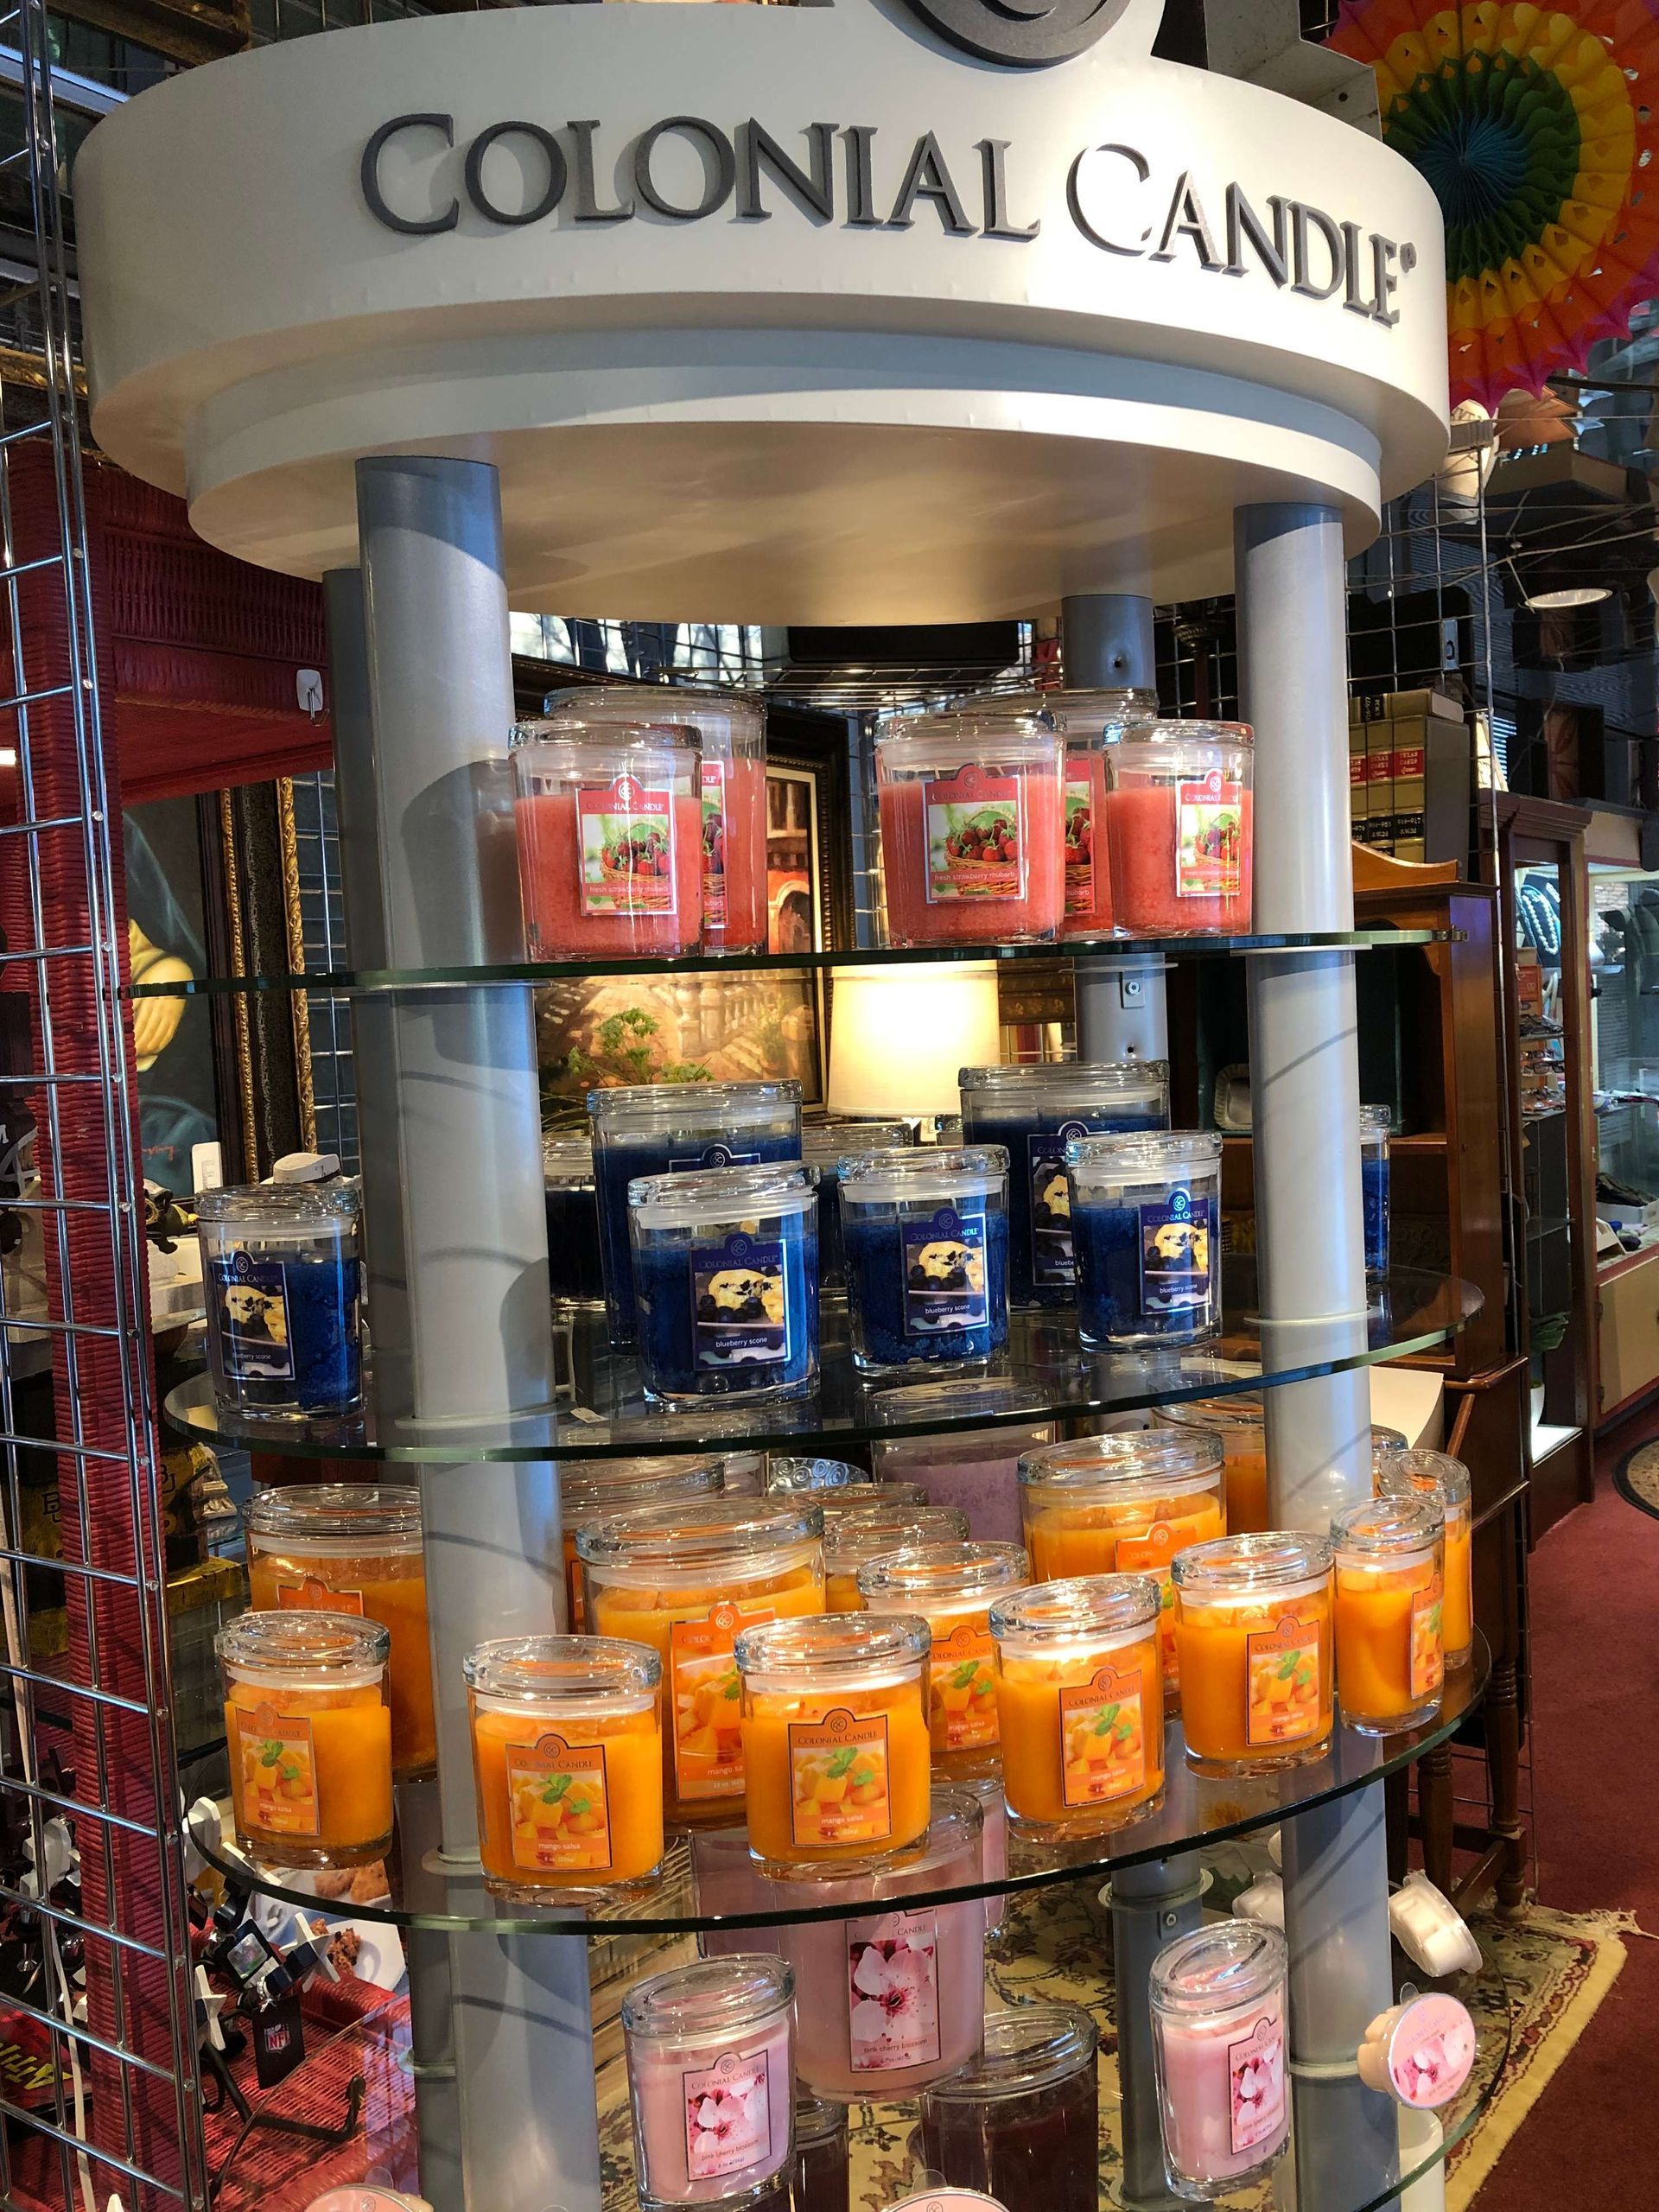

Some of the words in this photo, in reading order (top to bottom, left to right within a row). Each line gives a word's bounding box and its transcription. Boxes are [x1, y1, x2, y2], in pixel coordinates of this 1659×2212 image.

[360, 112, 1040, 243] COLONIAL
[934, 874, 951, 882] fresh
[952, 872, 988, 881] strawberry
[989, 870, 1015, 880] rhubarb
[1037, 1145, 1067, 1155] COLON
[1160, 1285, 1185, 1294] blueberry
[925, 1306, 954, 1315] blueberry
[715, 1339, 749, 1349] blueberry
[748, 1336, 768, 1344] scone
[232, 1351, 255, 1361] ueberry
[932, 1649, 967, 1660] OLONIAL
[798, 1735, 842, 1745] COLONIAL
[844, 1730, 876, 1743] CANDLE
[514, 1758, 555, 1770] CONIAL
[558, 1759, 592, 1770] CANDLE
[707, 1767, 733, 1777] mango
[821, 1816, 845, 1826] mango
[846, 1814, 864, 1822] salsa
[538, 1842, 561, 1852] mango
[897, 1924, 926, 1936] CANDLE
[901, 2038, 928, 2050] blossom
[691, 2077, 732, 2090] COLONIAL
[701, 2153, 715, 2162] pink
[735, 2139, 760, 2152] blossom
